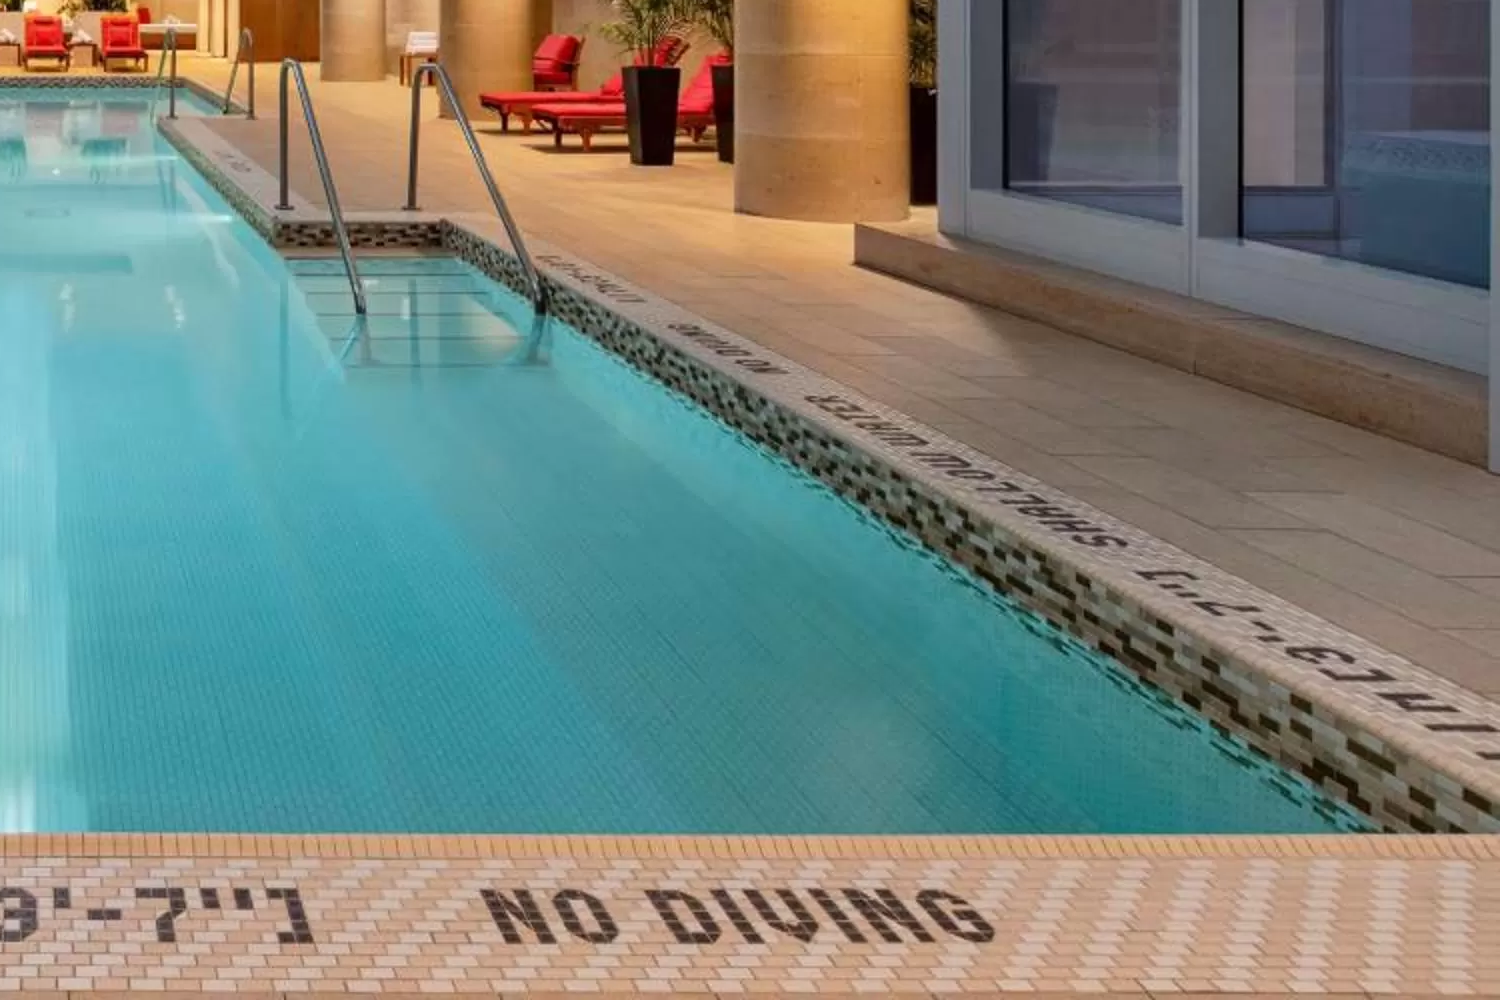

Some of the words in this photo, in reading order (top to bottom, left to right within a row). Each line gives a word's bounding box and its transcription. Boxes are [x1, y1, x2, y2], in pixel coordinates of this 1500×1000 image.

[804, 395, 930, 447] WATER
[910, 452, 1129, 547] SHALLOW
[479, 888, 620, 944] NO
[643, 888, 996, 944] DIVING
